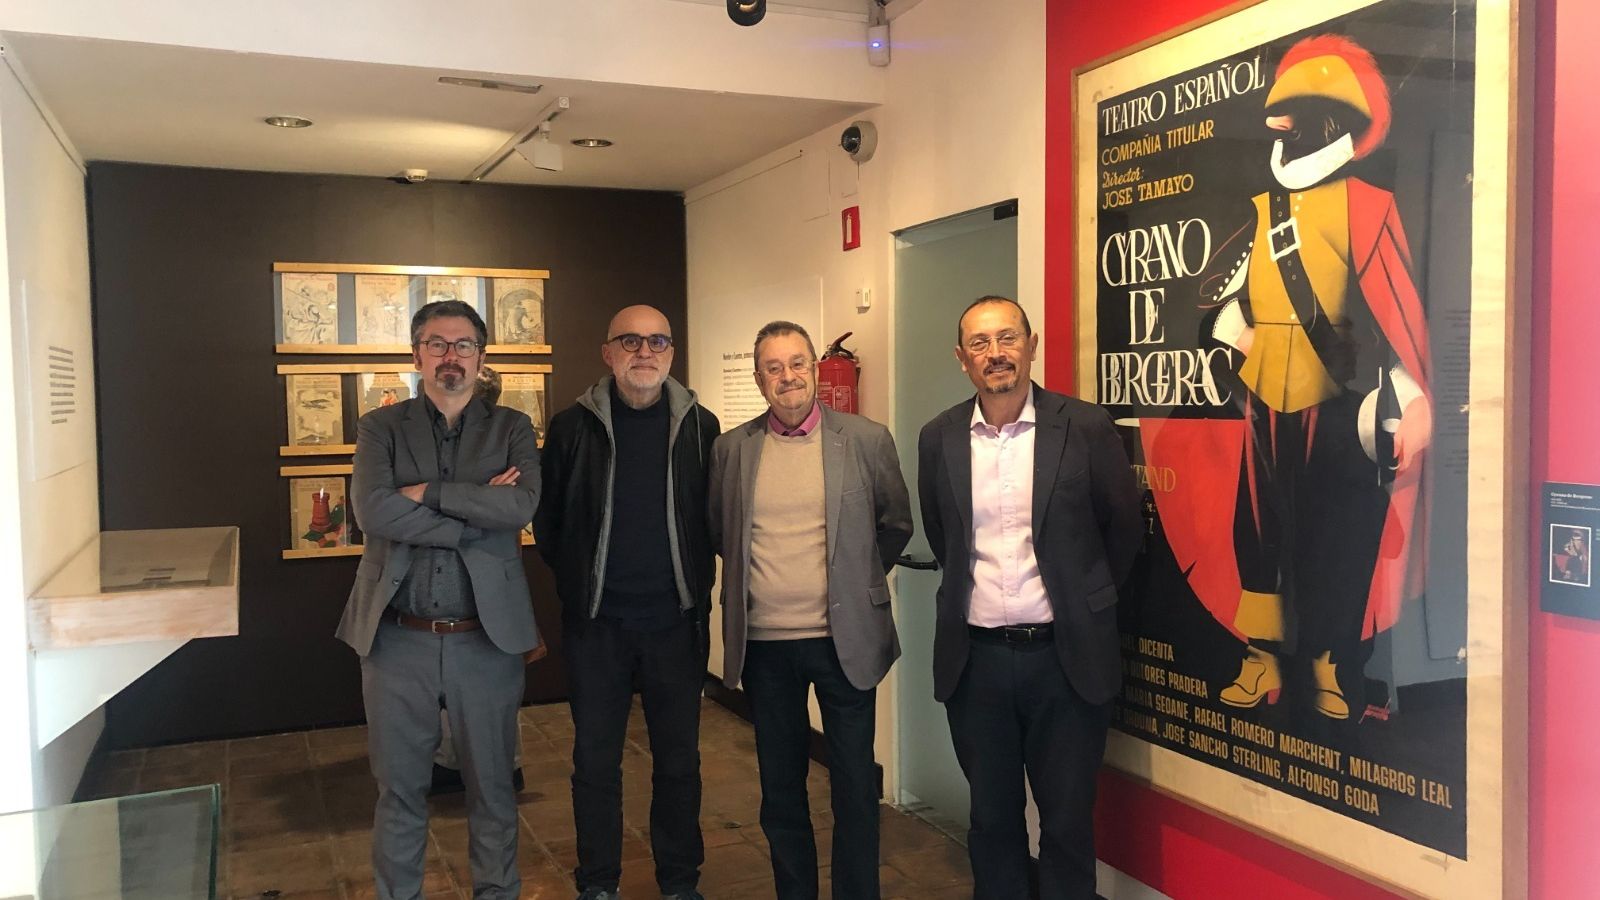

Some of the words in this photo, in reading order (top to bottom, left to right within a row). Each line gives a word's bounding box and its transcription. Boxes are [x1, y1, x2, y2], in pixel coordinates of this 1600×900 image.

[1102, 90, 1166, 136] TEATRO
[1174, 55, 1265, 115] ESPAÑOL
[1102, 133, 1162, 166] COMPAÑIA
[1167, 119, 1214, 149] TITULAR
[1102, 166, 1145, 188] Director:
[1102, 188, 1133, 210] JOSE
[1138, 174, 1194, 201] TAMAYO
[1102, 218, 1211, 287] CYRANO
[1128, 287, 1165, 345] DE
[1100, 347, 1232, 406] BERGERAC
[1130, 464, 1177, 493] TAND
[1138, 637, 1175, 662] DICENTA
[1168, 671, 1208, 699] PRADERA
[1155, 694, 1192, 723] SEOANE,
[1194, 706, 1227, 733] RAFAEL
[1231, 717, 1275, 748] ROMERO
[1280, 733, 1345, 775] MARCHENT,
[1349, 756, 1416, 797] MILAGROS
[1422, 778, 1452, 809] LEAL
[1162, 722, 1185, 745] JOSE
[1189, 730, 1229, 760] SANCHO
[1233, 745, 1284, 783] STERLING,
[1288, 765, 1339, 801] ALFONSO
[1344, 785, 1380, 817] GODA
